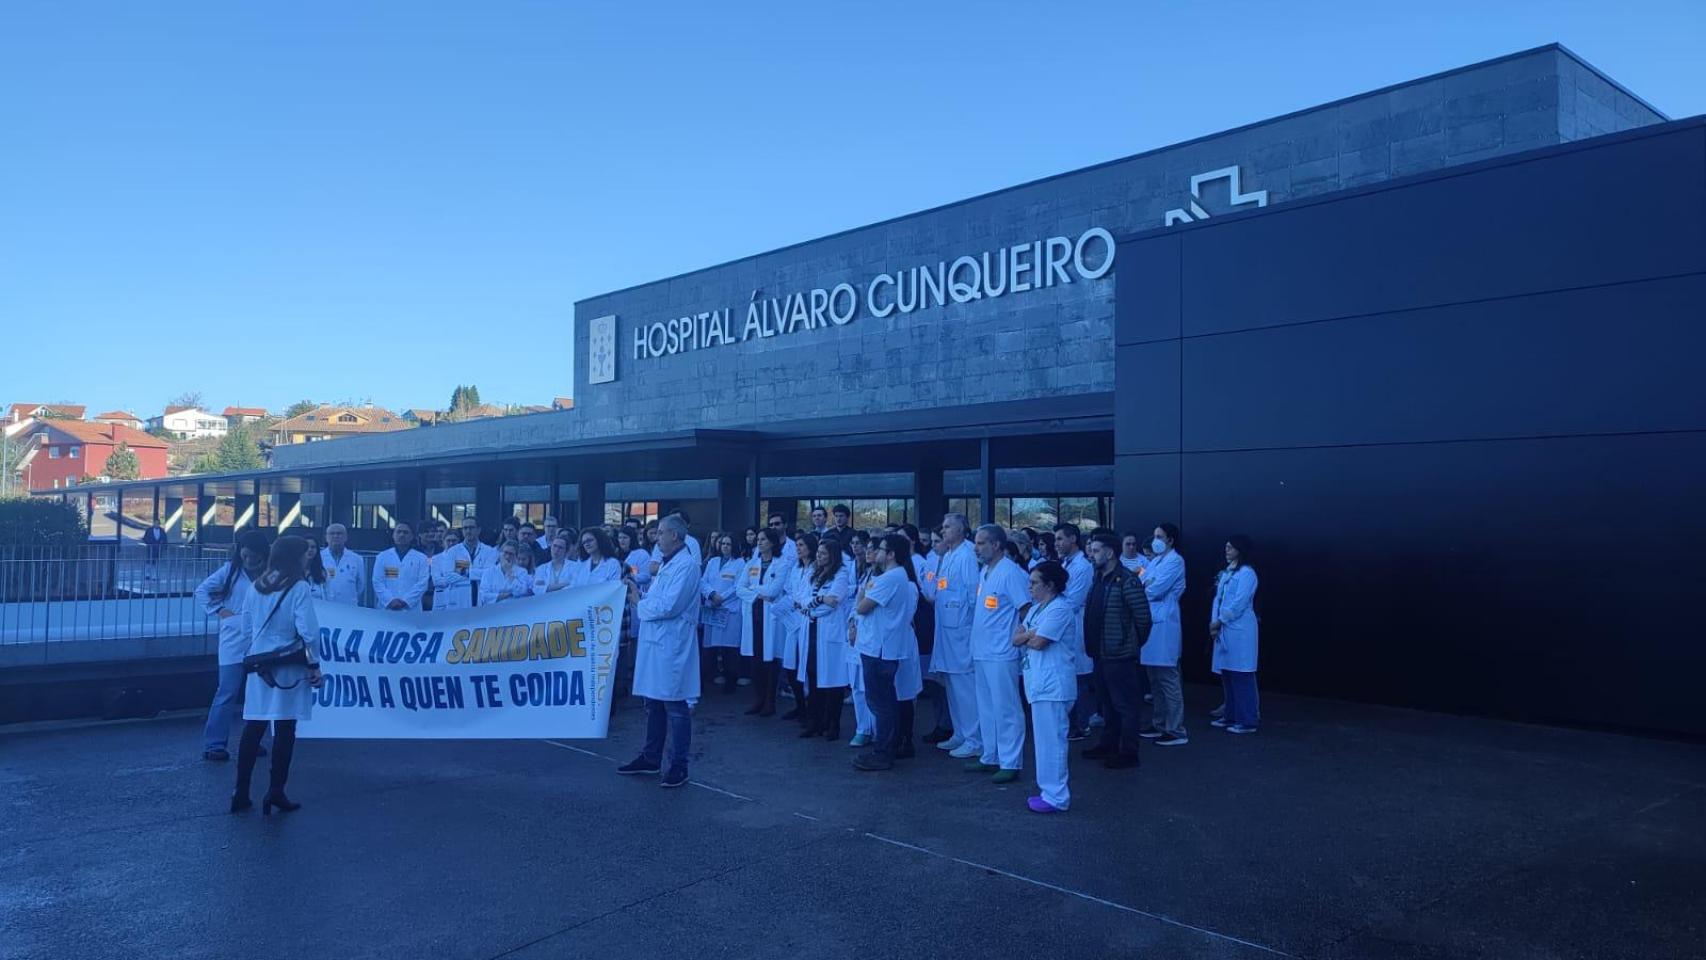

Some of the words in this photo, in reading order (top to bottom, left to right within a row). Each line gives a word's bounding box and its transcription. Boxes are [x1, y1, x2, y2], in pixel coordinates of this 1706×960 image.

[633, 308, 735, 360] HOSPITAL
[742, 289, 857, 341] ÁLVARO
[867, 227, 1116, 319] CUNQUEIRO
[369, 630, 443, 664] NOSA
[446, 619, 587, 664] SANIDADE
[312, 674, 374, 708] OIDA
[378, 675, 395, 709] A
[400, 676, 464, 712] QUEN
[470, 674, 503, 708] TE
[509, 670, 586, 707] COIDA
